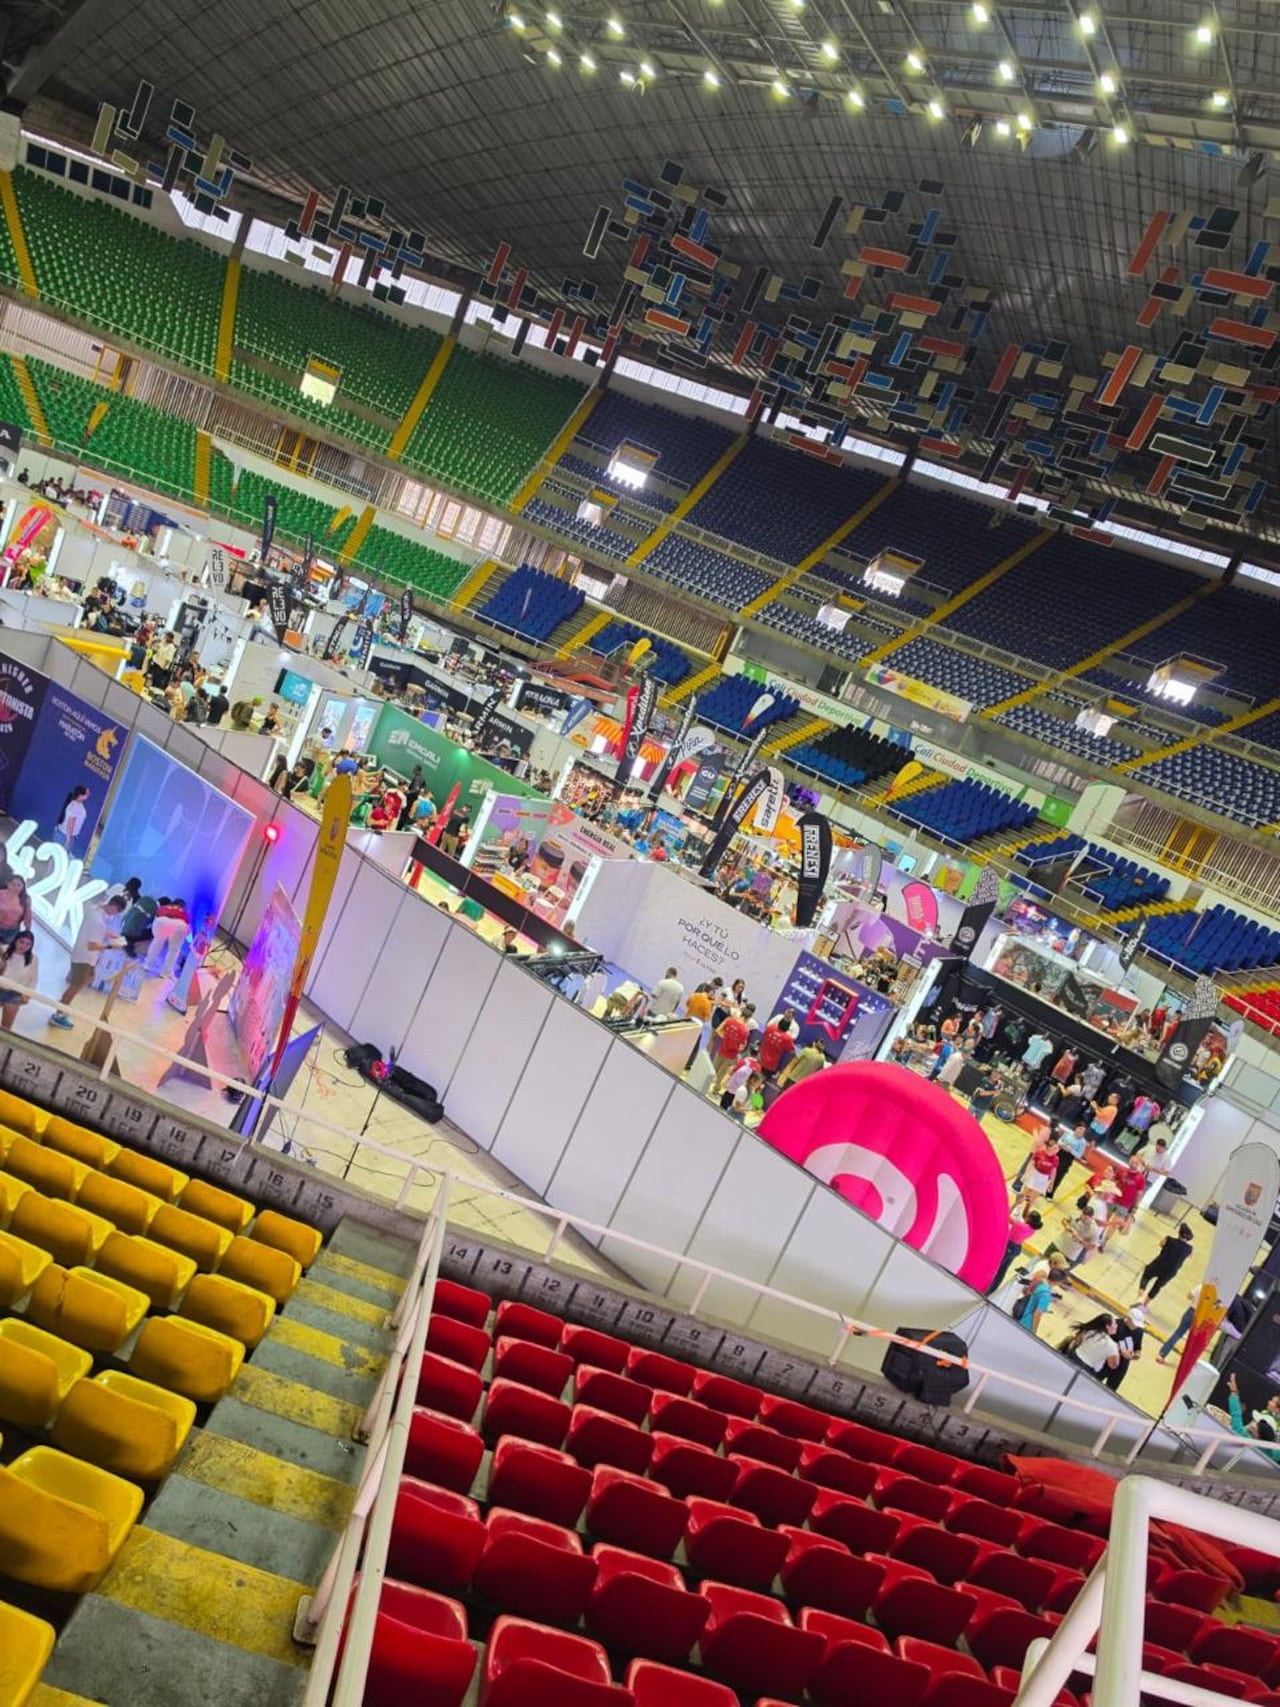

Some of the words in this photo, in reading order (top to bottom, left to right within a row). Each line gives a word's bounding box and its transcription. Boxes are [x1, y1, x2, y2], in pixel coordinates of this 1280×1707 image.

[213, 573, 224, 583] VO
[271, 585, 285, 598] RE
[274, 611, 287, 624] VO
[768, 678, 787, 695] Cali
[787, 687, 819, 708] Ciudad
[817, 701, 863, 726] Deportiva
[701, 769, 715, 780] GU
[914, 743, 934, 758] Cali
[932, 753, 969, 774] Ciudad
[966, 767, 1014, 794] Deportiva
[5, 820, 109, 948] 42K
[682, 936, 725, 966] HACES?
[724, 947, 740, 961] LO
[24, 1062, 42, 1078] 21
[75, 1085, 98, 1103] 20
[125, 1106, 143, 1122] 19
[169, 1126, 187, 1142] 18
[220, 1148, 236, 1162] 17
[268, 1170, 285, 1186] 16
[318, 1192, 335, 1209] 15
[450, 1244, 468, 1259] 14
[492, 1259, 513, 1275] 13
[543, 1278, 561, 1291] 12
[593, 1295, 605, 1307] 11
[635, 1308, 654, 1323] 10
[690, 1329, 701, 1341] 9
[733, 1344, 745, 1357] 8
[781, 1363, 794, 1375] 7
[832, 1381, 843, 1393] 6
[874, 1396, 885, 1408] 5
[957, 1425, 969, 1436] 3
